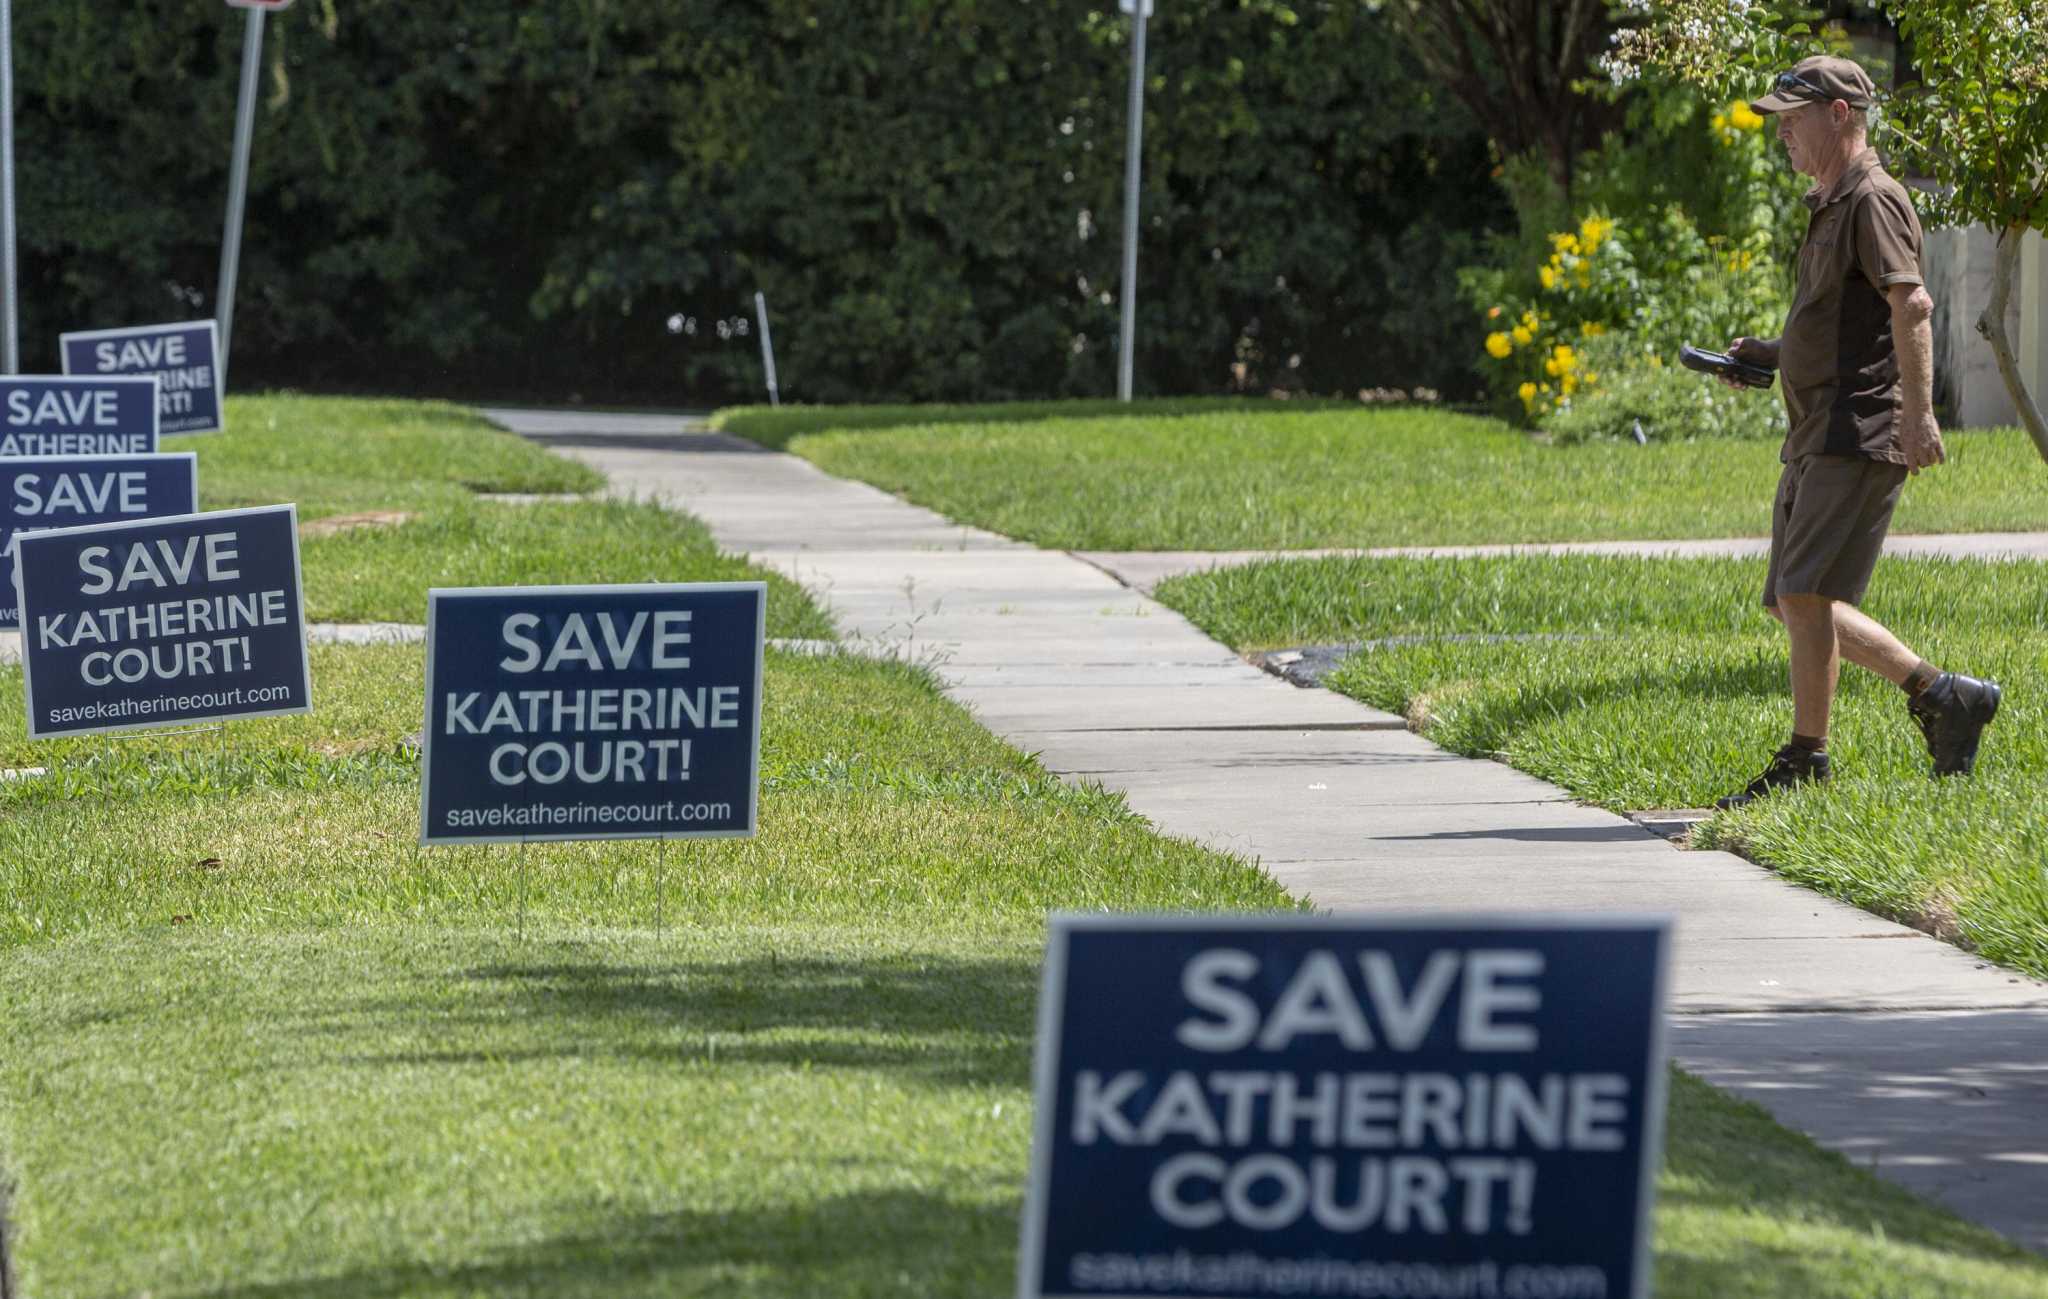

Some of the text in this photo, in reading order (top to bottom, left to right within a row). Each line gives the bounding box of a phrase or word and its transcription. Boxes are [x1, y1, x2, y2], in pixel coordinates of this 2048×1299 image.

[96, 335, 187, 372] SAVE
[7, 390, 118, 426] SAVE
[0, 433, 147, 454] ATHERINE
[13, 472, 148, 516] SAVE
[79, 532, 240, 595] SAVE
[39, 590, 287, 650] KATHERINE
[500, 610, 692, 673] SAVE
[80, 636, 252, 686] COURT!
[50, 685, 291, 723] savekatherinecourt.com
[445, 686, 740, 735] KATHERINE
[489, 739, 692, 786] COURT!
[447, 801, 731, 827] savekatherinecourt.com
[1176, 946, 1546, 1053] SAVE
[1071, 1069, 1630, 1152] KATHERINE
[1149, 1151, 1539, 1236] COURT!
